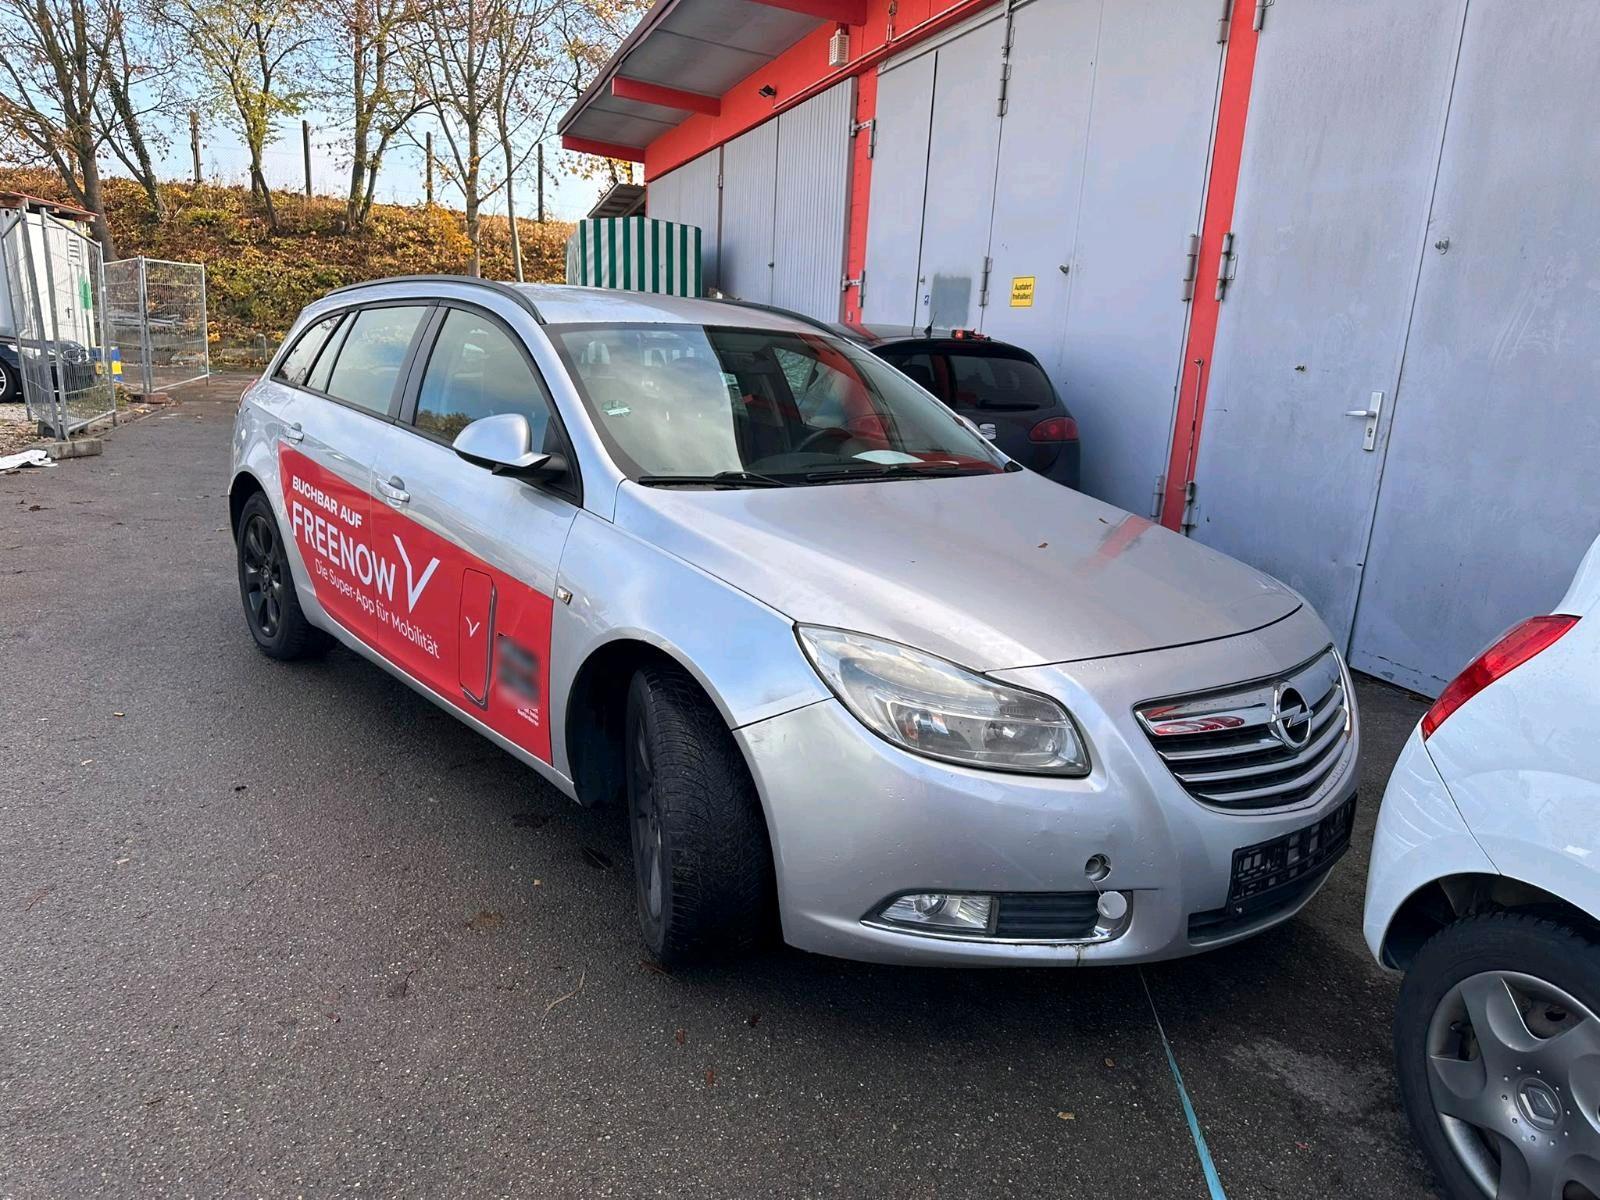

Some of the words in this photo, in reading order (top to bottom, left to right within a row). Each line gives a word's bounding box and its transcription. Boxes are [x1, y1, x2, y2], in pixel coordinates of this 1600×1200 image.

[292, 474, 338, 516] BUCHBAR
[340, 505, 363, 528] AUF
[292, 500, 396, 602] FREENOW
[315, 558, 329, 580] Die
[329, 568, 375, 615] Super-App
[375, 599, 389, 623] für
[391, 611, 440, 659] Mobilität
